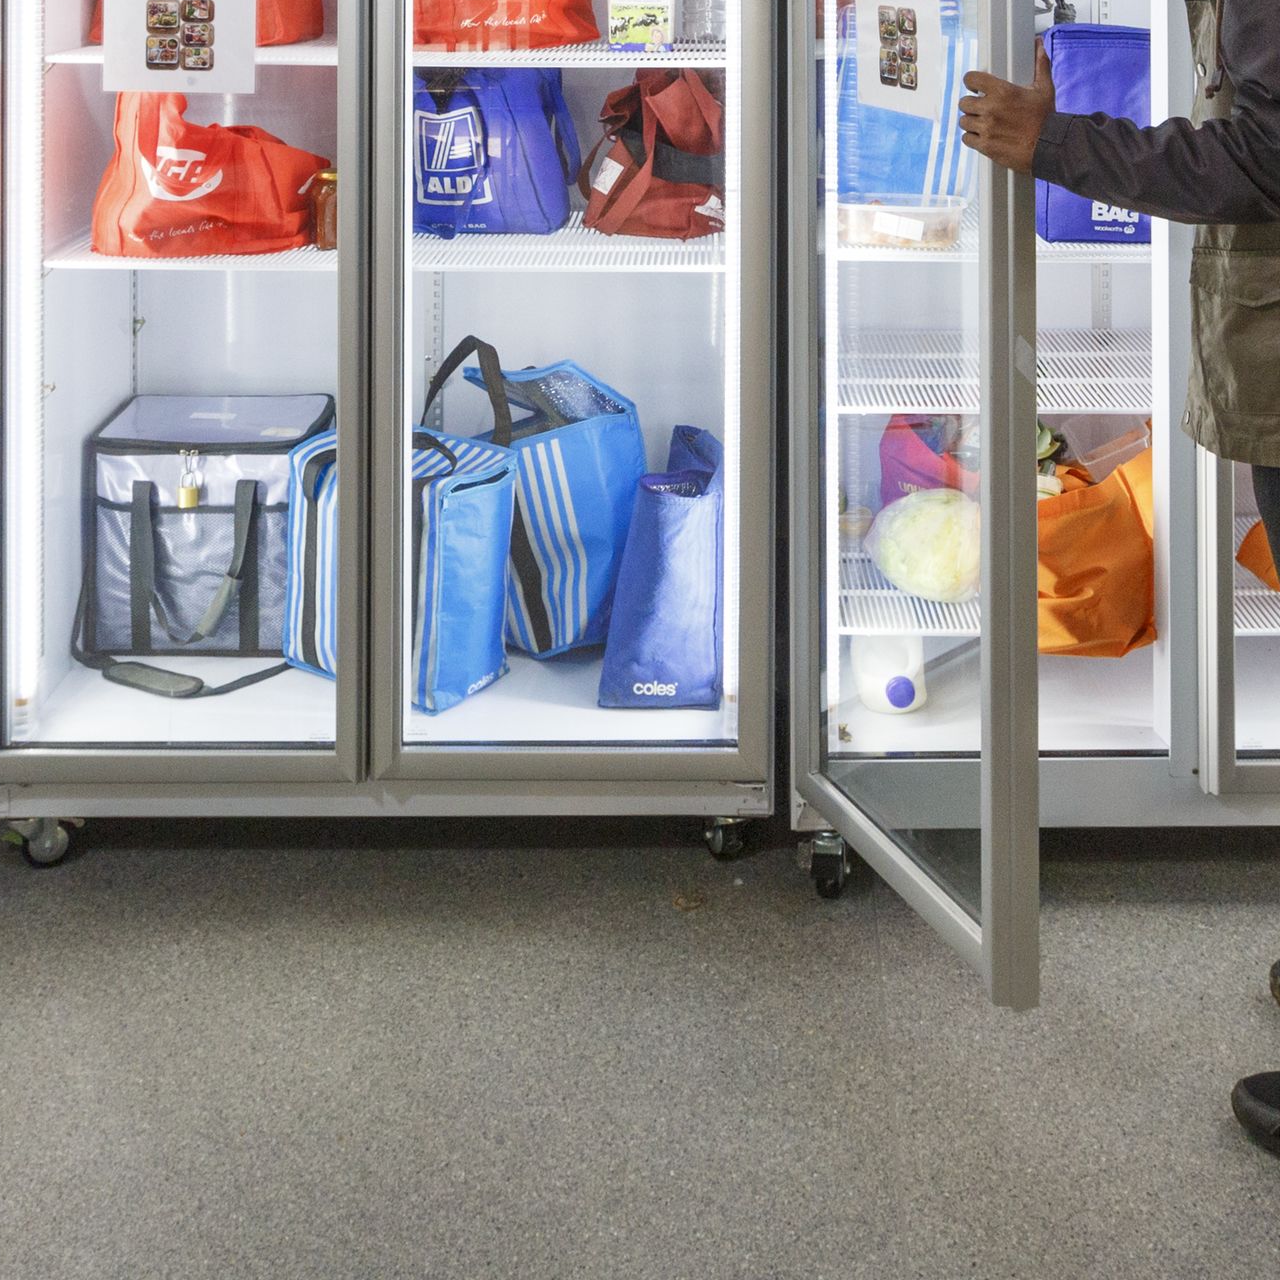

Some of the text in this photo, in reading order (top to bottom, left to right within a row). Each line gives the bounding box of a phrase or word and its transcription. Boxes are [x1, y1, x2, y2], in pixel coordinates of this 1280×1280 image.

[1092, 200, 1139, 223] BAG
[467, 672, 495, 695] coles
[633, 680, 676, 696] coles
